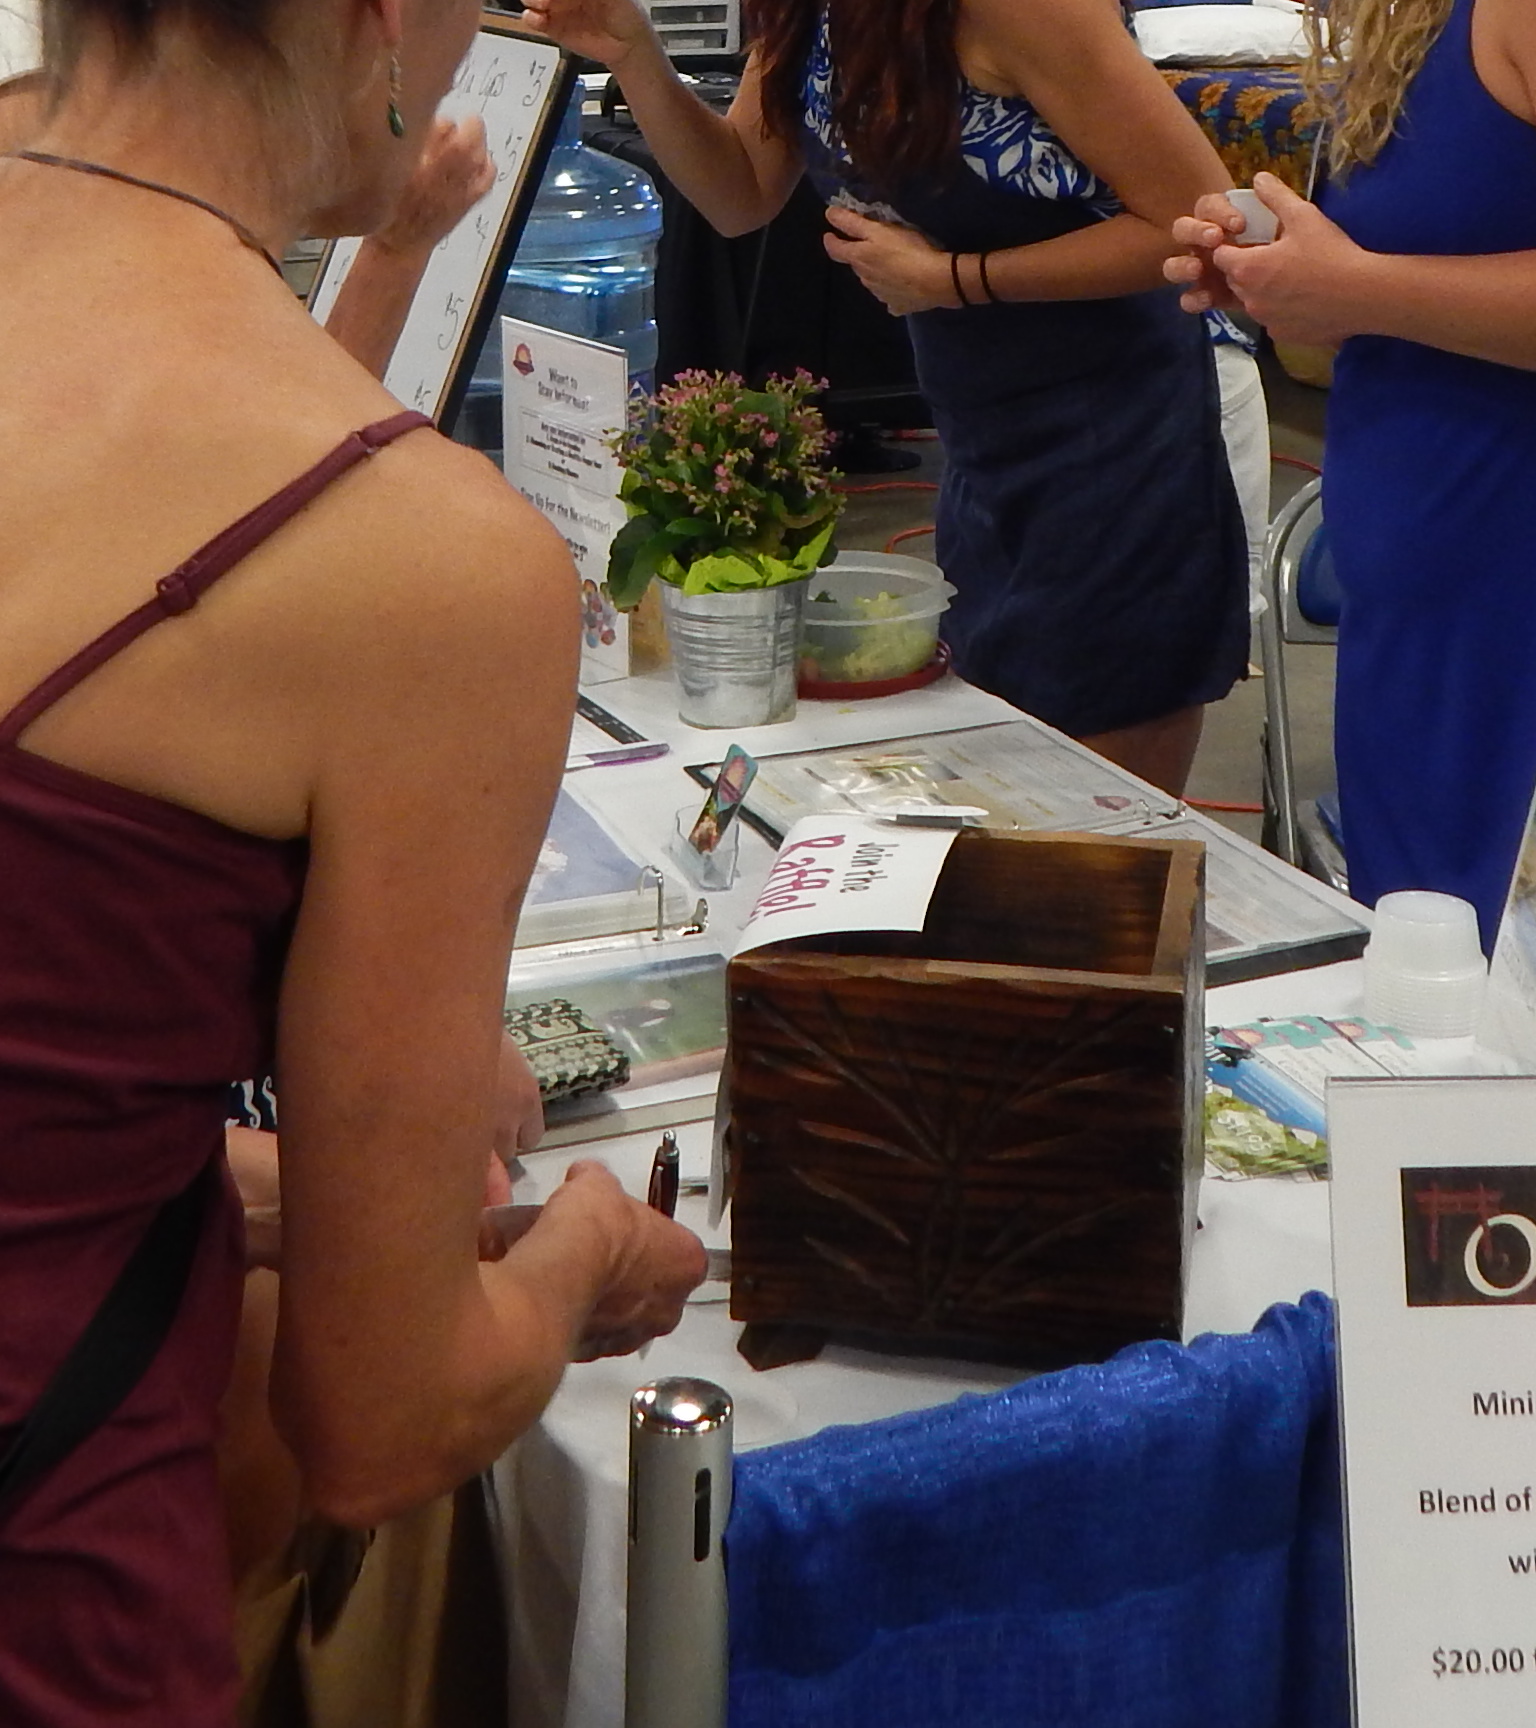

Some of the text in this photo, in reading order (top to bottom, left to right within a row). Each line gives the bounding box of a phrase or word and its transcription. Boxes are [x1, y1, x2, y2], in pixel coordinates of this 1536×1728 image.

[839, 842, 900, 894] Join the
[1472, 1390, 1535, 1417] Mini
[1419, 1487, 1497, 1516] Blend
[1505, 1486, 1533, 1513] of
[1431, 1646, 1525, 1680] $20.00
